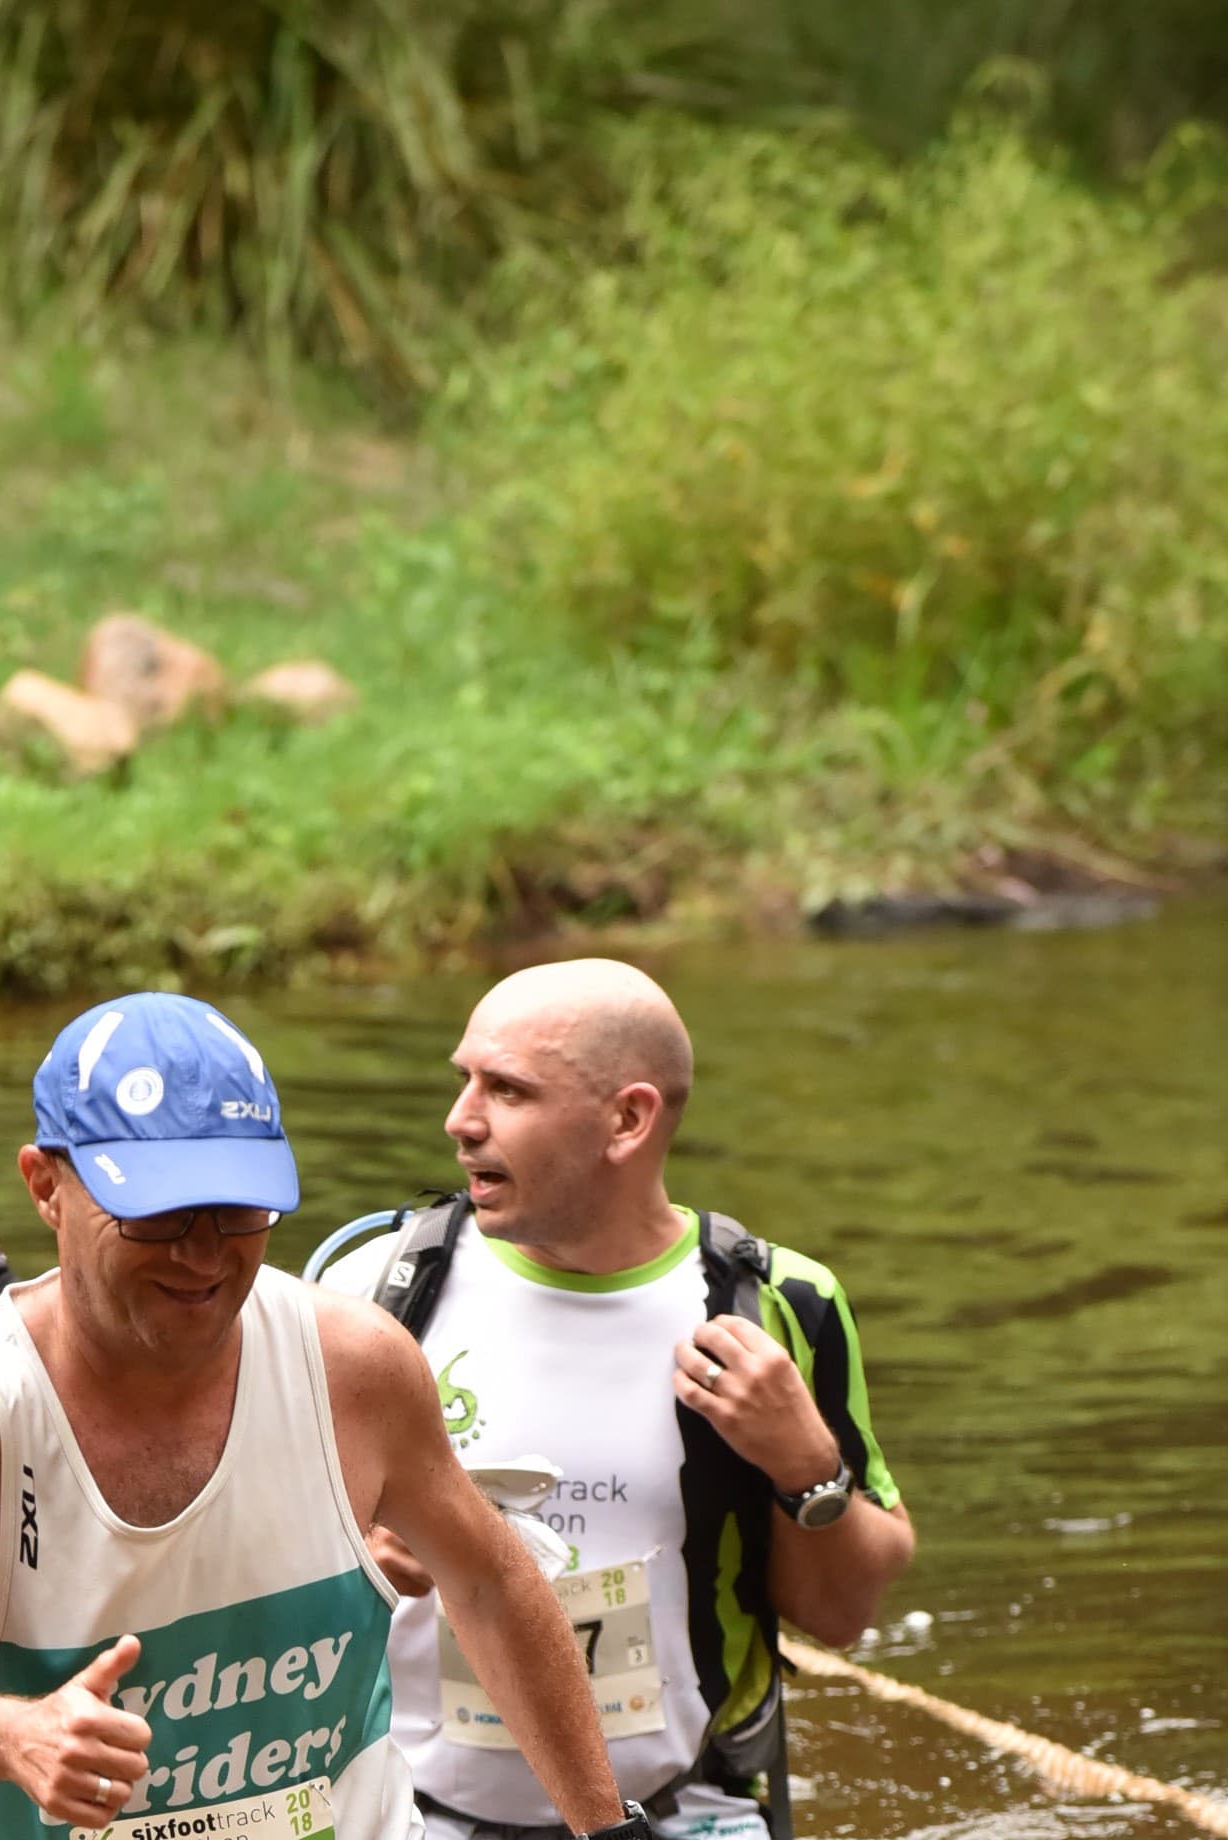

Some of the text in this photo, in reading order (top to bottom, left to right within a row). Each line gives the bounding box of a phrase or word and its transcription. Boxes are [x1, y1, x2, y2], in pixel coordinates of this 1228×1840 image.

[118, 1631, 353, 1720] ydney
[122, 1714, 347, 1814] riders
[285, 1788, 310, 1814] 20
[290, 1812, 313, 1836] 18
